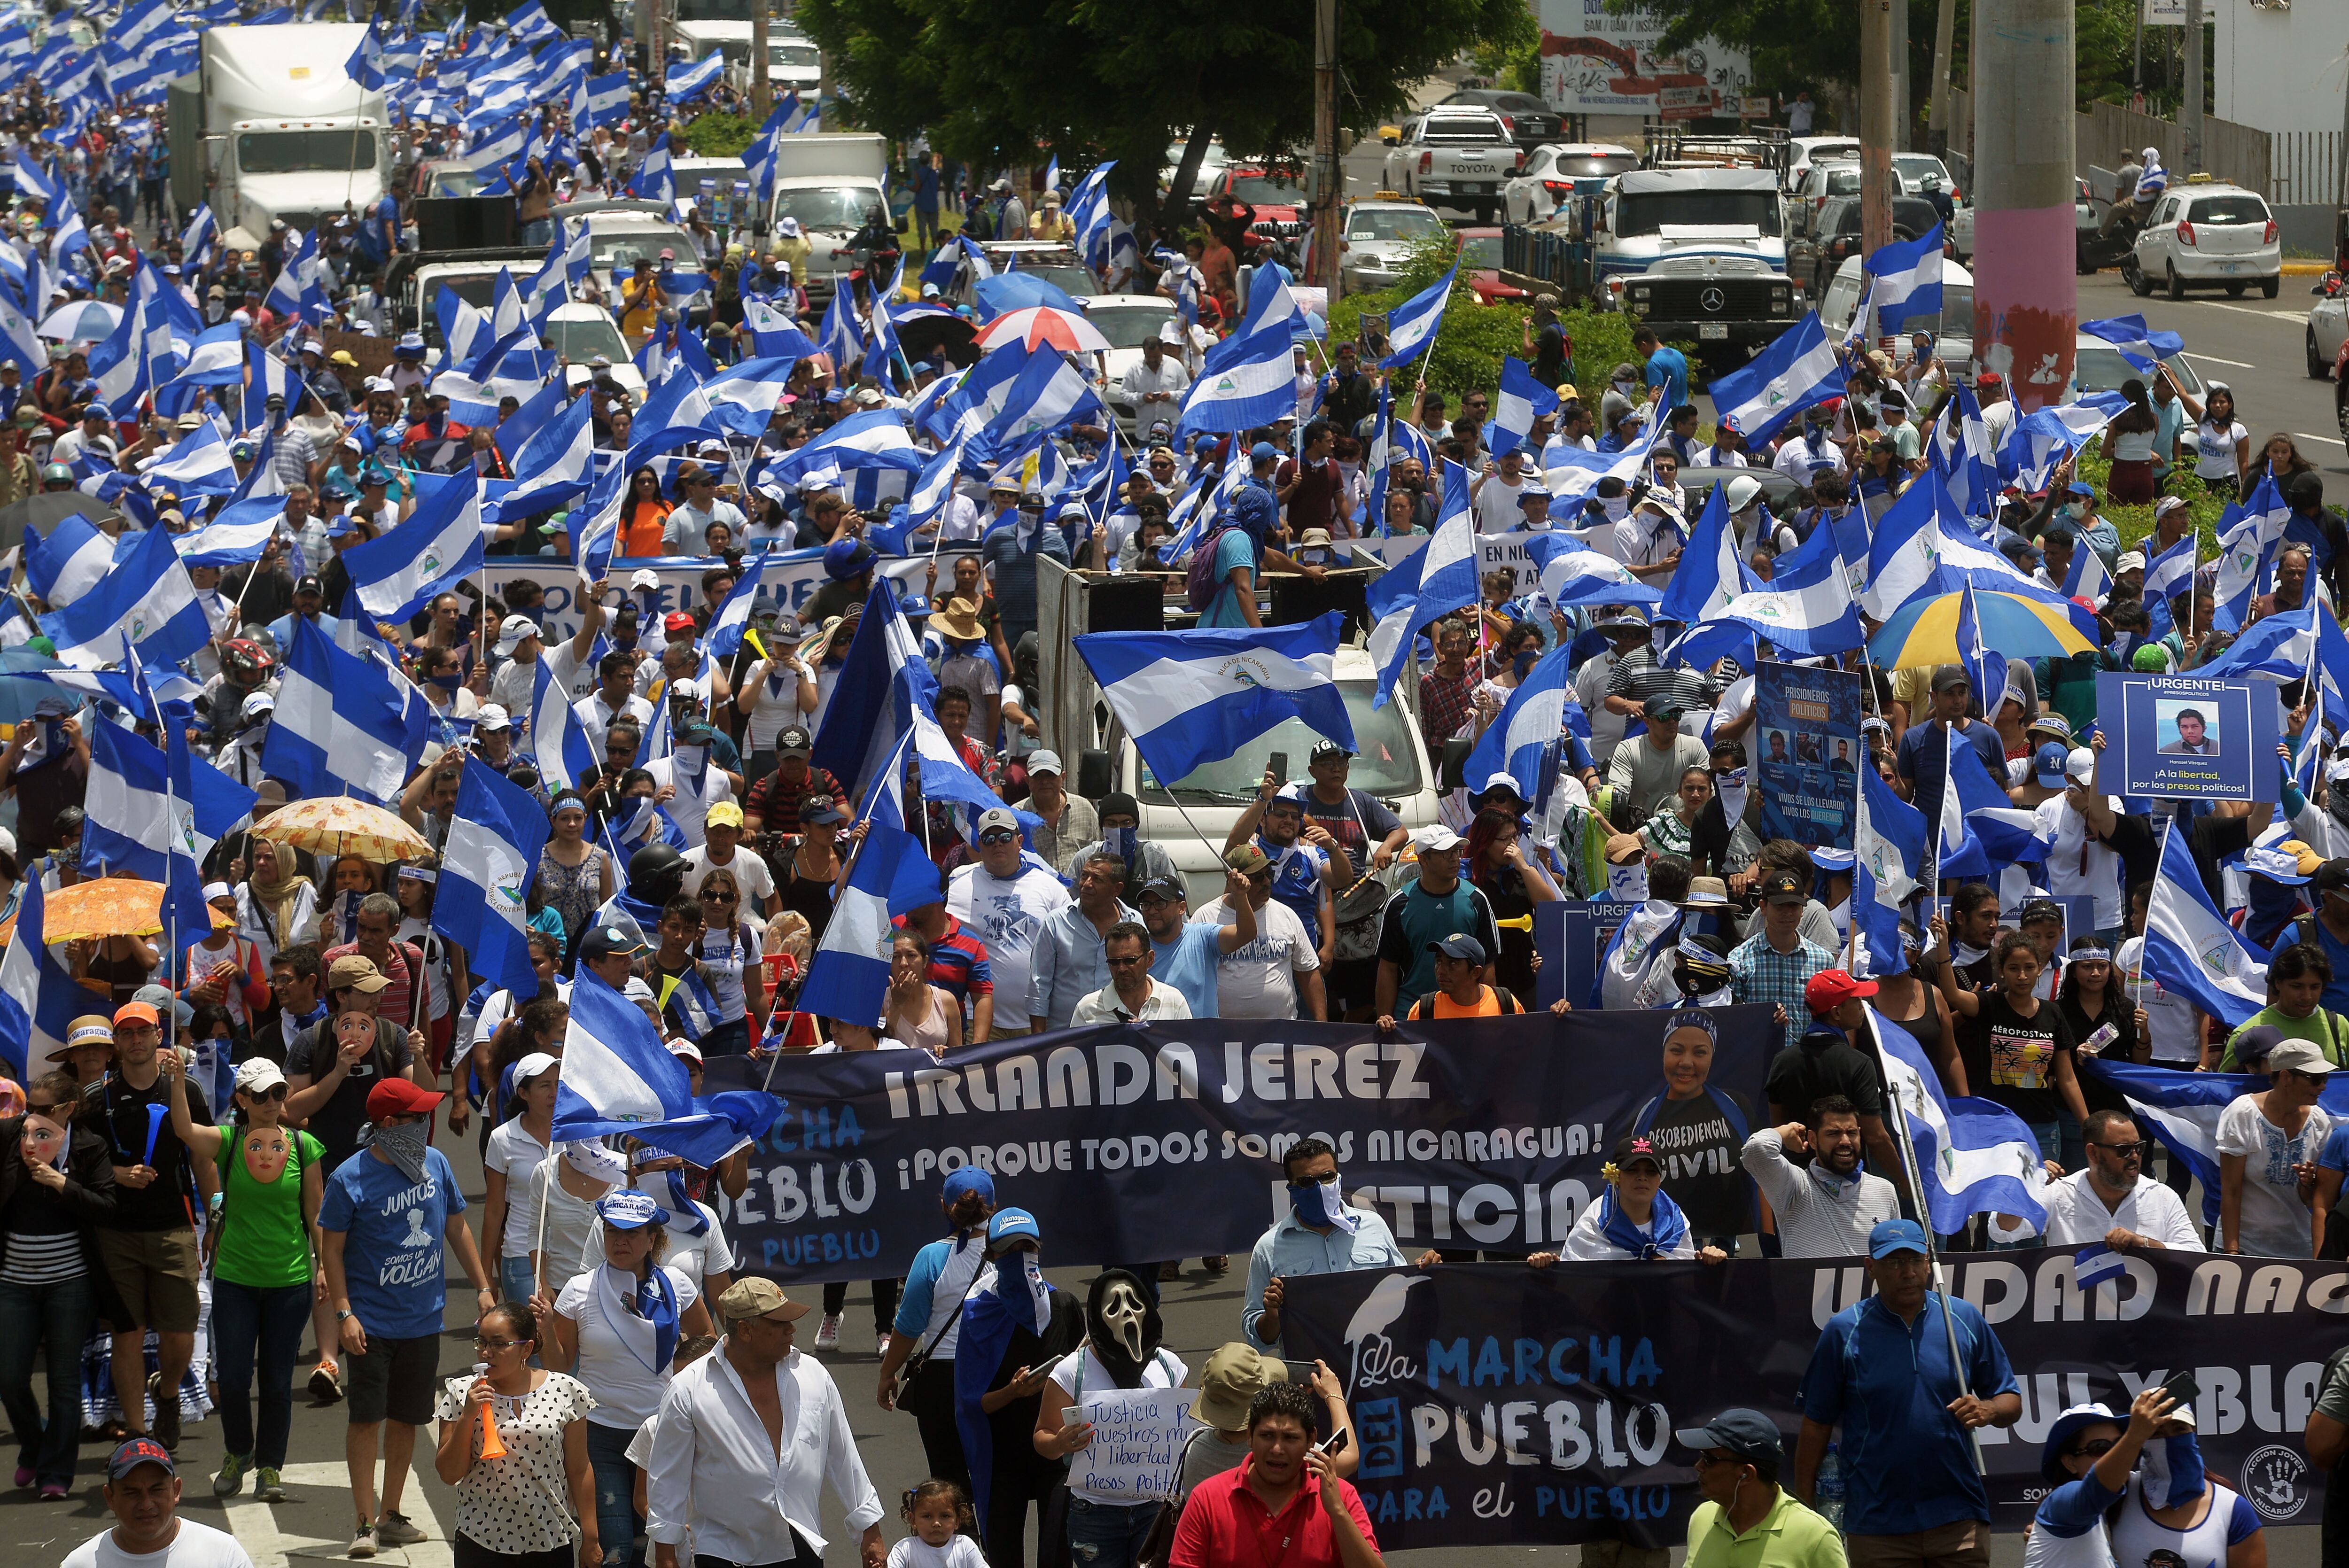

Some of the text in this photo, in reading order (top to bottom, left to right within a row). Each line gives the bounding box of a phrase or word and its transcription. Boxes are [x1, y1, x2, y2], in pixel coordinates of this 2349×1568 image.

[1450, 164, 1497, 173] TOYOTA
[1486, 545, 1503, 562] EN
[1241, 657, 1270, 681] NICARAGUA
[2147, 677, 2226, 691] ¡URGENTE!
[1785, 686, 1830, 703] PRISIONEROS
[1791, 702, 1826, 719] POLÍTICOS
[690, 723, 711, 732] adida
[2155, 769, 2221, 781] ¡A la libertad,
[2132, 780, 2246, 793] por los presos políticos!
[1778, 792, 1845, 811] VIVOS SE LOS LLEVARON
[1781, 805, 1842, 823] VIVOS LOS QUEREMOS
[885, 1041, 1431, 1119] IRLANDA JEREZ
[1649, 1117, 1731, 1149] DESOBEDIENCIA
[897, 1140, 1072, 1191] ¡PORQUE
[1081, 1129, 1209, 1171] TODOS
[1367, 1121, 1604, 1163] NICARAGUA!
[381, 1178, 436, 1217] JUNTOS
[612, 1202, 652, 1214] NICARAGUA
[384, 1250, 425, 1266] SOMOS UN
[762, 1228, 880, 1268] PUEBLO
[379, 1249, 442, 1287] VOLCÁN
[1358, 1334, 1664, 1390] La MARCHA
[1088, 1399, 1161, 1425] Justicia
[1090, 1425, 1160, 1445] nuestros
[1363, 1398, 1671, 1471] DEL PUEBLO
[1109, 1444, 1170, 1466] libertad
[2278, 1450, 2305, 1474] JOVEN
[1361, 1481, 1670, 1524] PARA el PUEBLO
[2256, 1496, 2304, 1516] NICARAGUA
